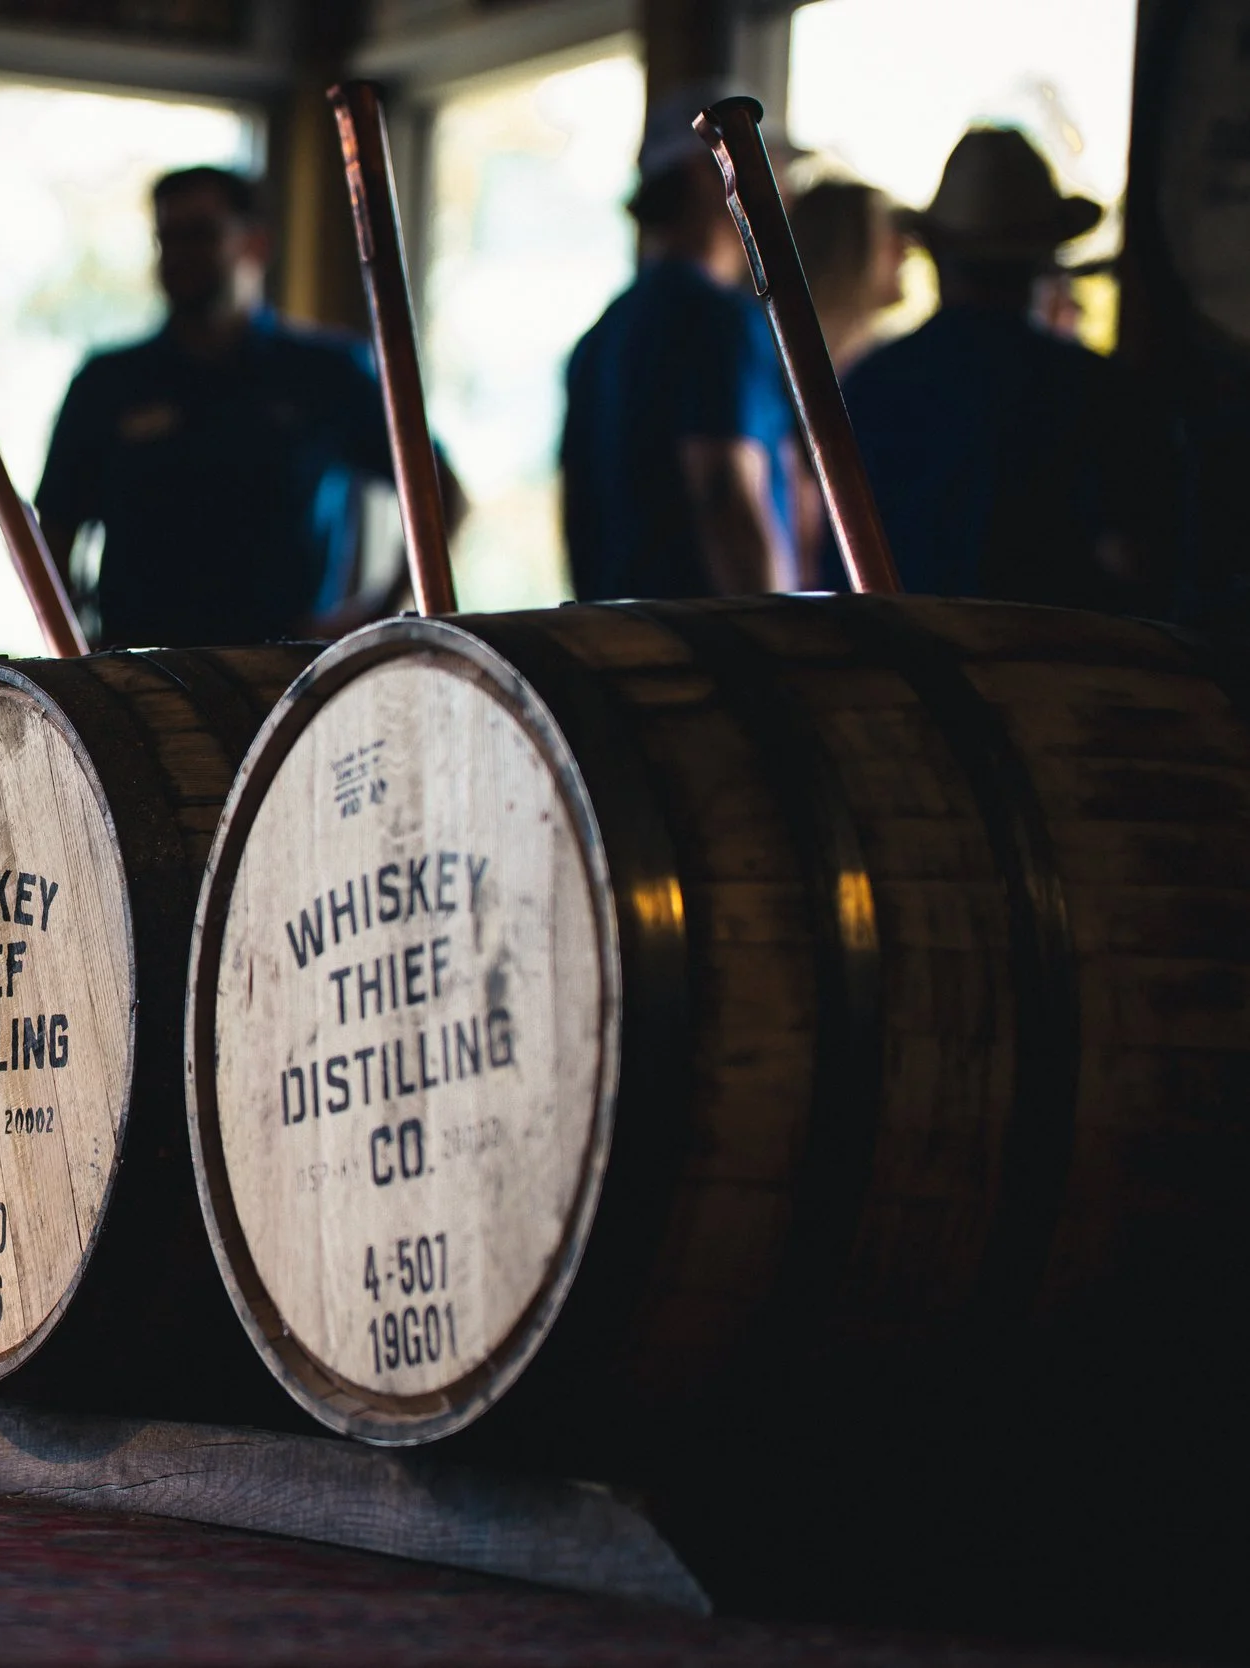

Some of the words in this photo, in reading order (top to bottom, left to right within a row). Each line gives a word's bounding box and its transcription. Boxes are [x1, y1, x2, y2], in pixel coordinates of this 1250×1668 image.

[286, 853, 488, 969] WHISKEY
[329, 937, 448, 1024] THIEF
[280, 1008, 513, 1126] DISTILLING
[5, 1106, 54, 1135] 20002
[363, 1230, 448, 1300] 4-507
[368, 1302, 458, 1374] 19G01
